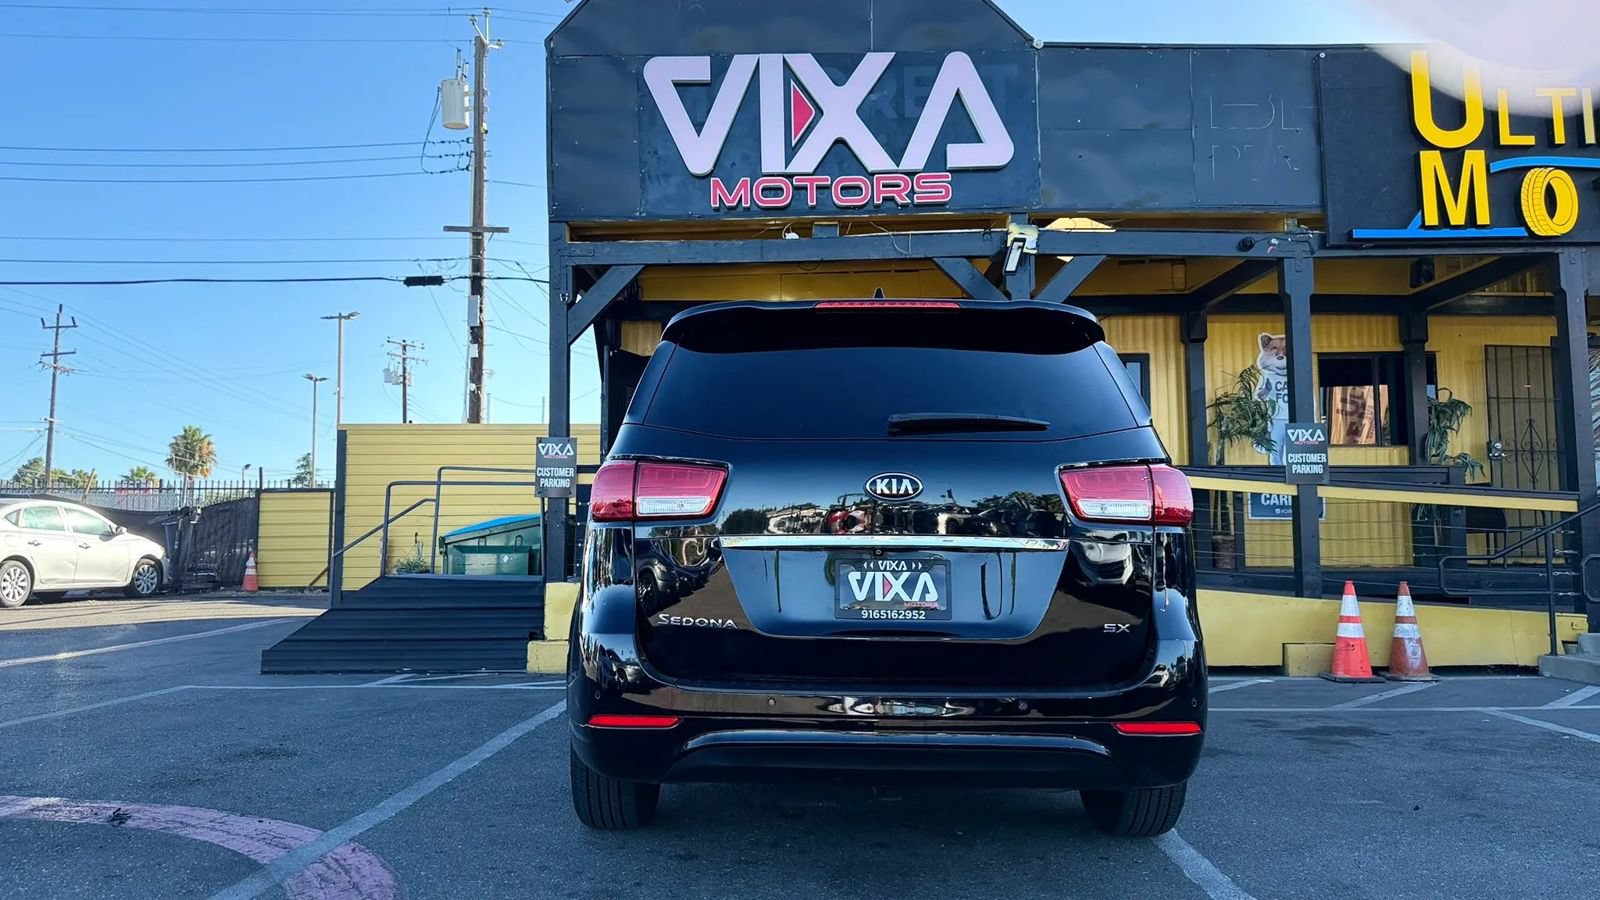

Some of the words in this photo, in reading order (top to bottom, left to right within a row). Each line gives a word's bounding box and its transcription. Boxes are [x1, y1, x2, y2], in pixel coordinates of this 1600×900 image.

[642, 51, 1014, 175] VIXA
[710, 172, 952, 209] MOTORS
[1287, 429, 1325, 441] VIXA
[538, 443, 574, 455] VIXA
[1288, 453, 1327, 463] CUSTOMER
[537, 467, 574, 477] CUSTOMER
[1292, 464, 1323, 474] PARKING
[540, 478, 570, 488] PARKING
[876, 478, 914, 494] KIA
[878, 560, 908, 570] VIXA
[848, 571, 938, 602] VIXA
[861, 610, 926, 619] 9165162952
[1103, 623, 1130, 633] SX
